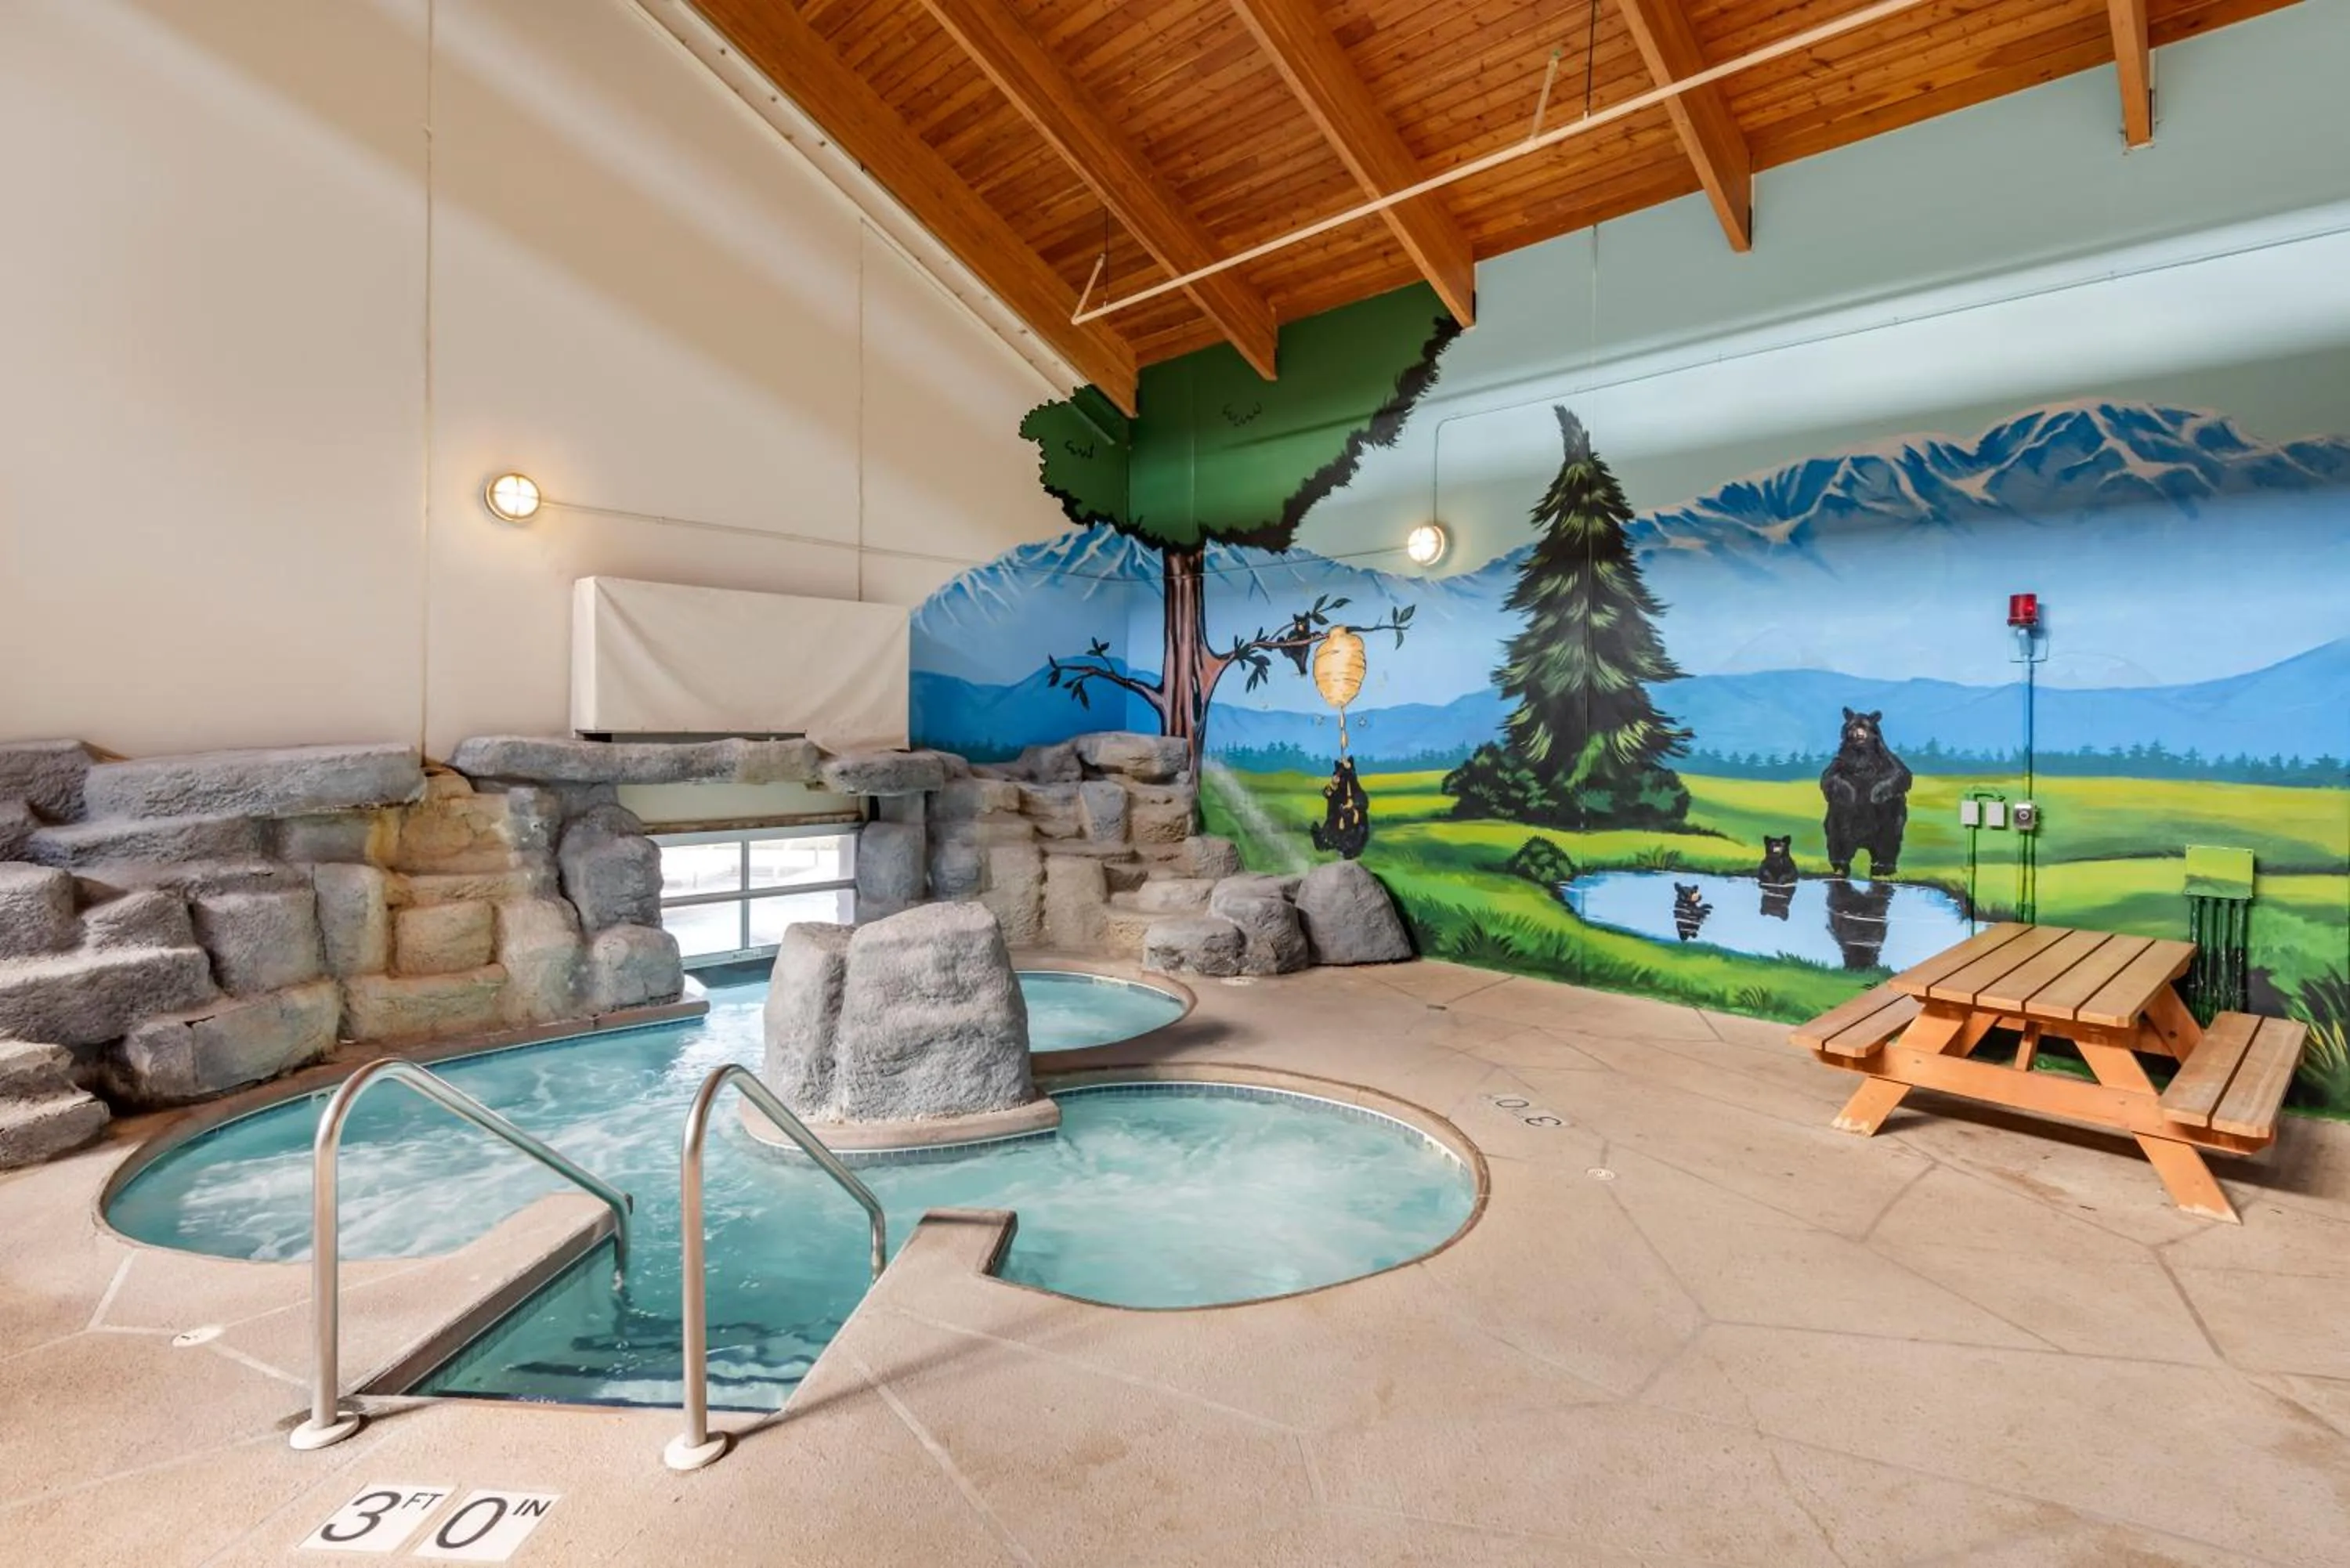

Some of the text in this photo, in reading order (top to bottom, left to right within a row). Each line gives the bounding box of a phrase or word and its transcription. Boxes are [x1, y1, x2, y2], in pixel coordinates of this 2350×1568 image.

[320, 1490, 402, 1542] 3
[401, 1492, 444, 1510] FT
[512, 1498, 551, 1517] IN
